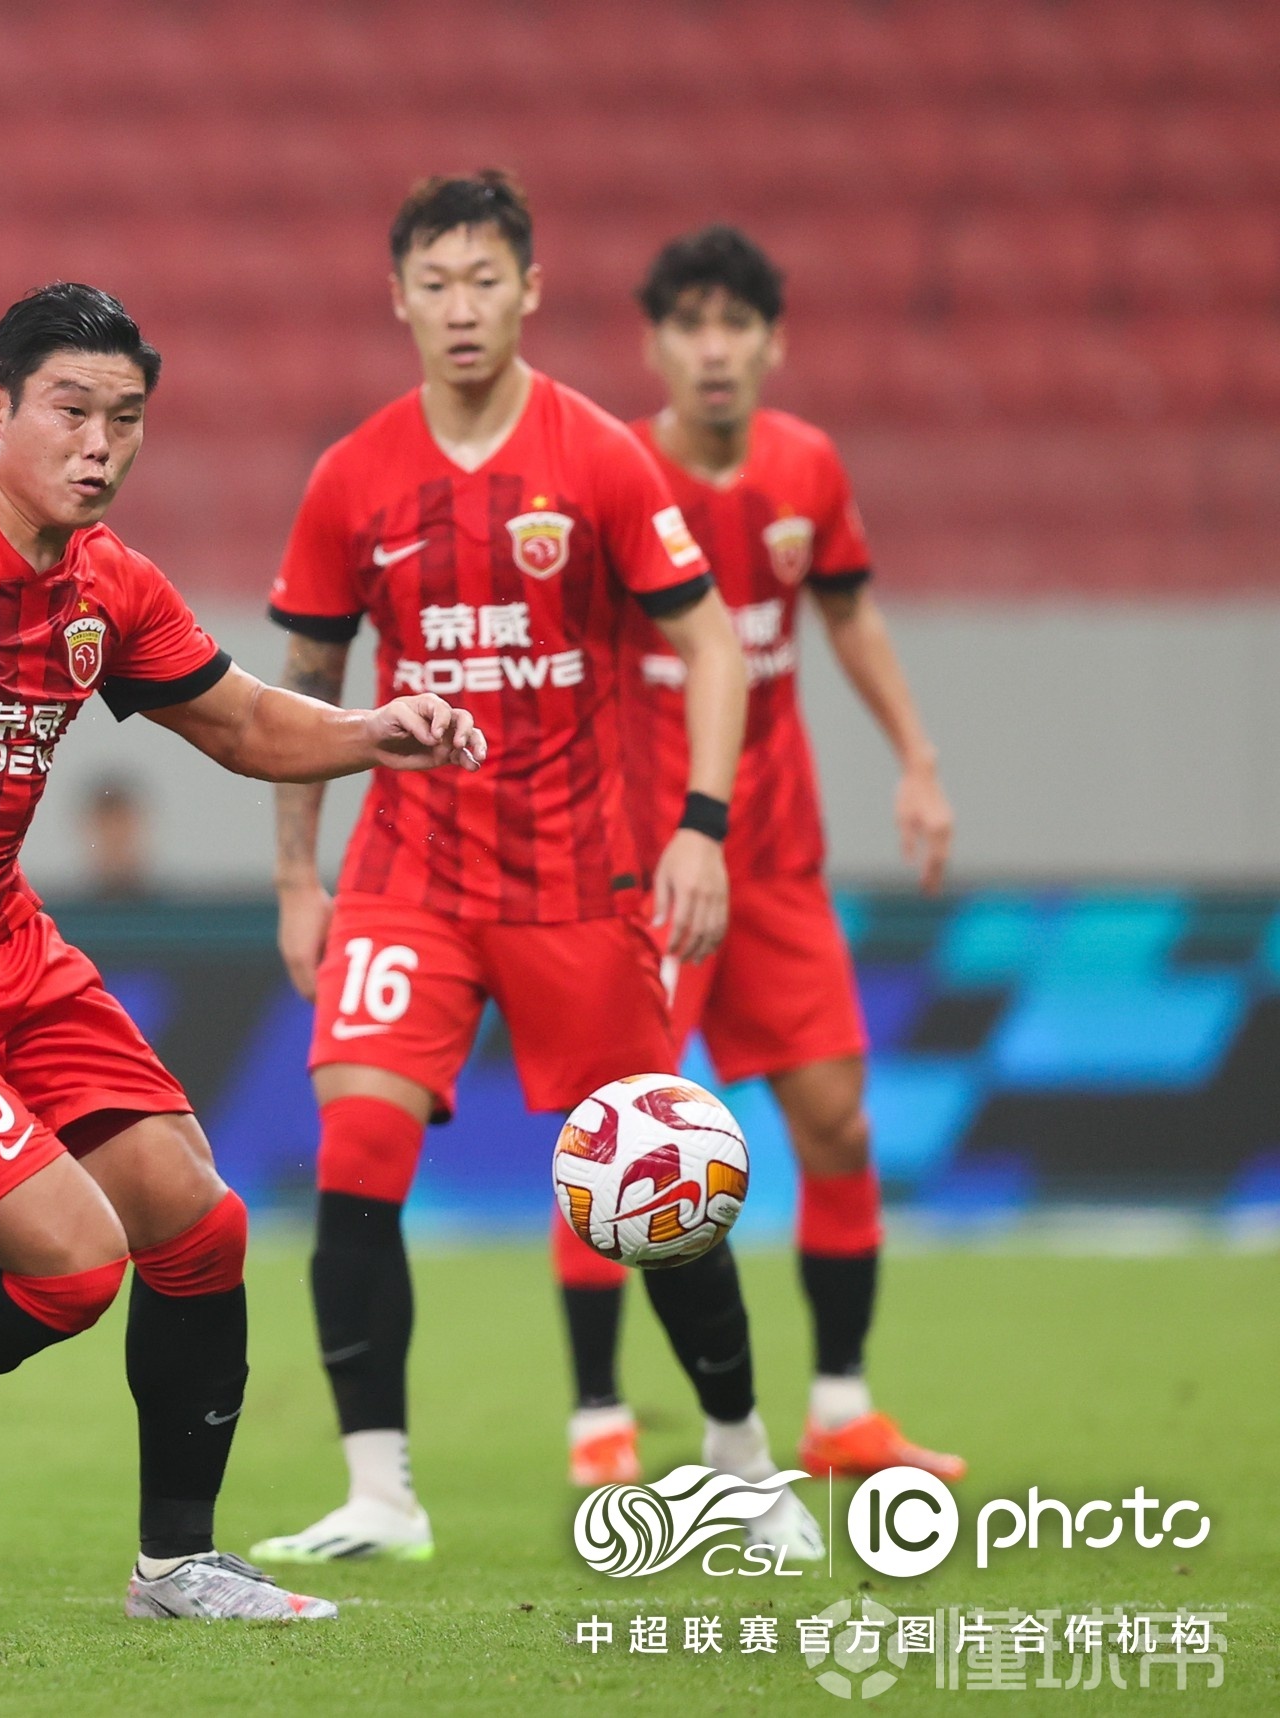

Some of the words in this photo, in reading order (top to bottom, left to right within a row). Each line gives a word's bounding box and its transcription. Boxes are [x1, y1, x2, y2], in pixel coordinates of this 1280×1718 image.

[419, 601, 533, 650] 荣威
[392, 648, 584, 694] ROEWE
[338, 936, 419, 1025] 16
